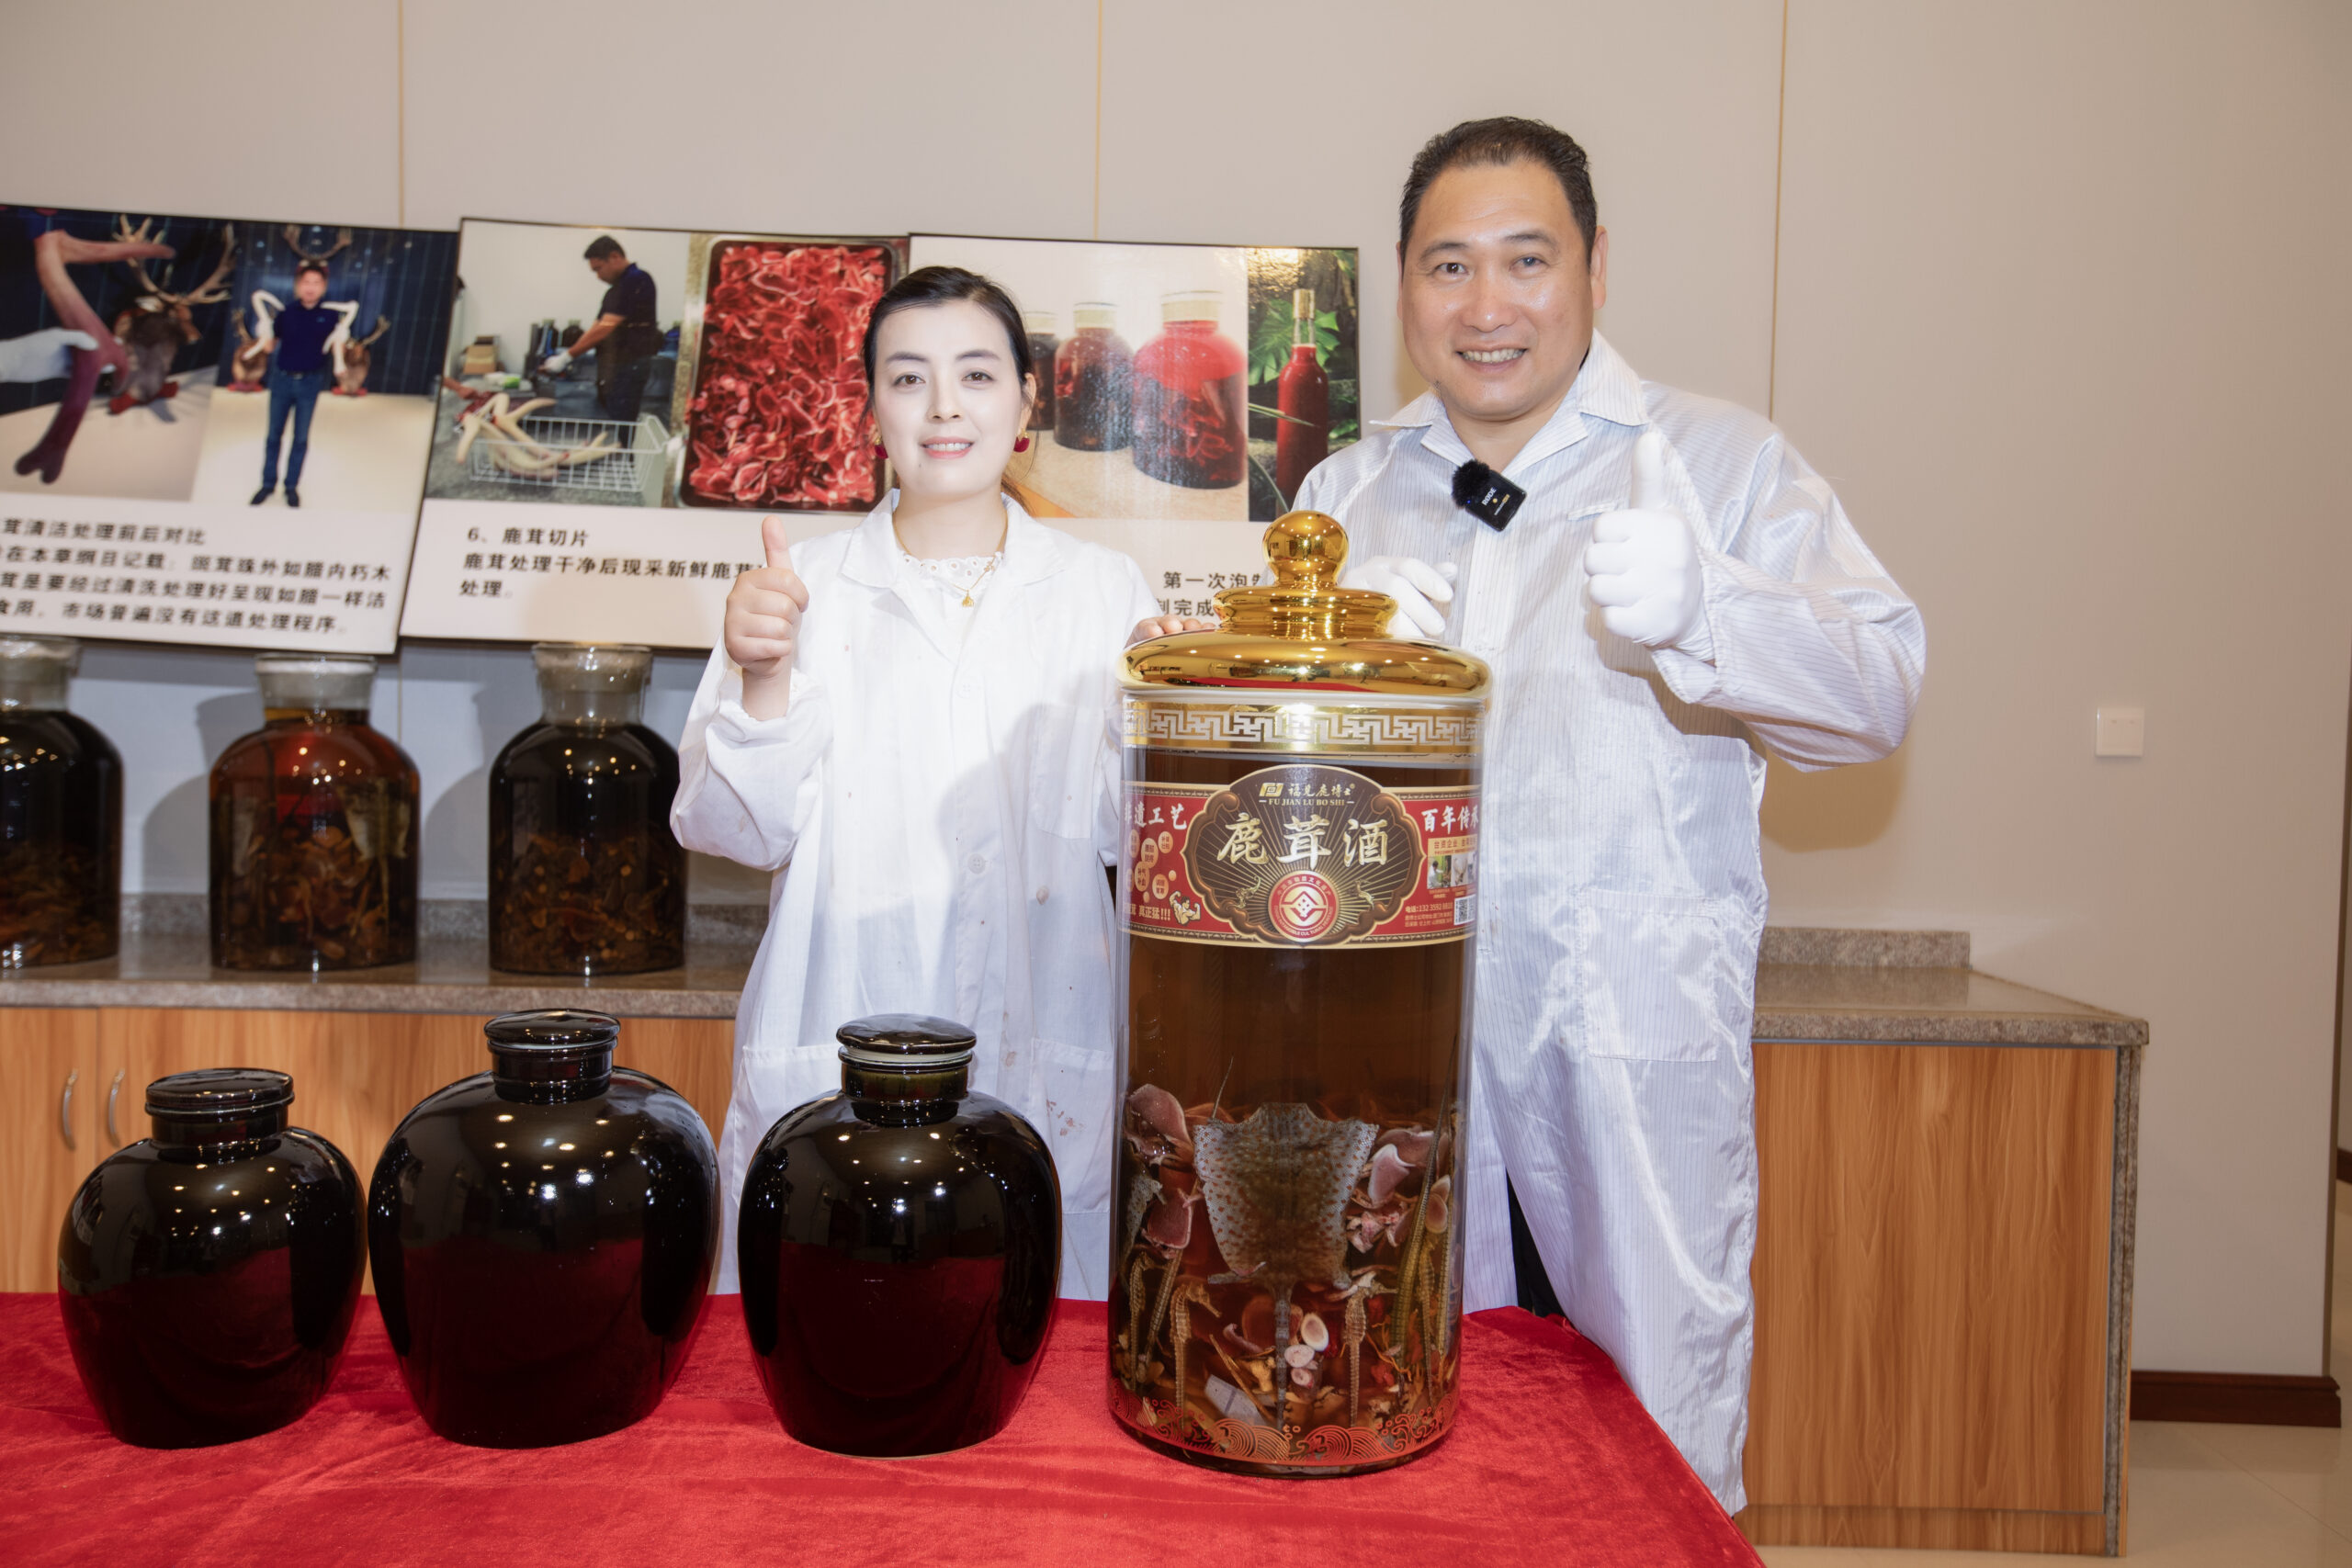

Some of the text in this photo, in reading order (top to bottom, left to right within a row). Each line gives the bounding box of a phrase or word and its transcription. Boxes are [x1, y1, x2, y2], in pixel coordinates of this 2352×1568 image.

[463, 553, 763, 581] 鹿茸处理干净后现采新鲜鹿
[1216, 812, 1389, 871] 鹿茸酒
